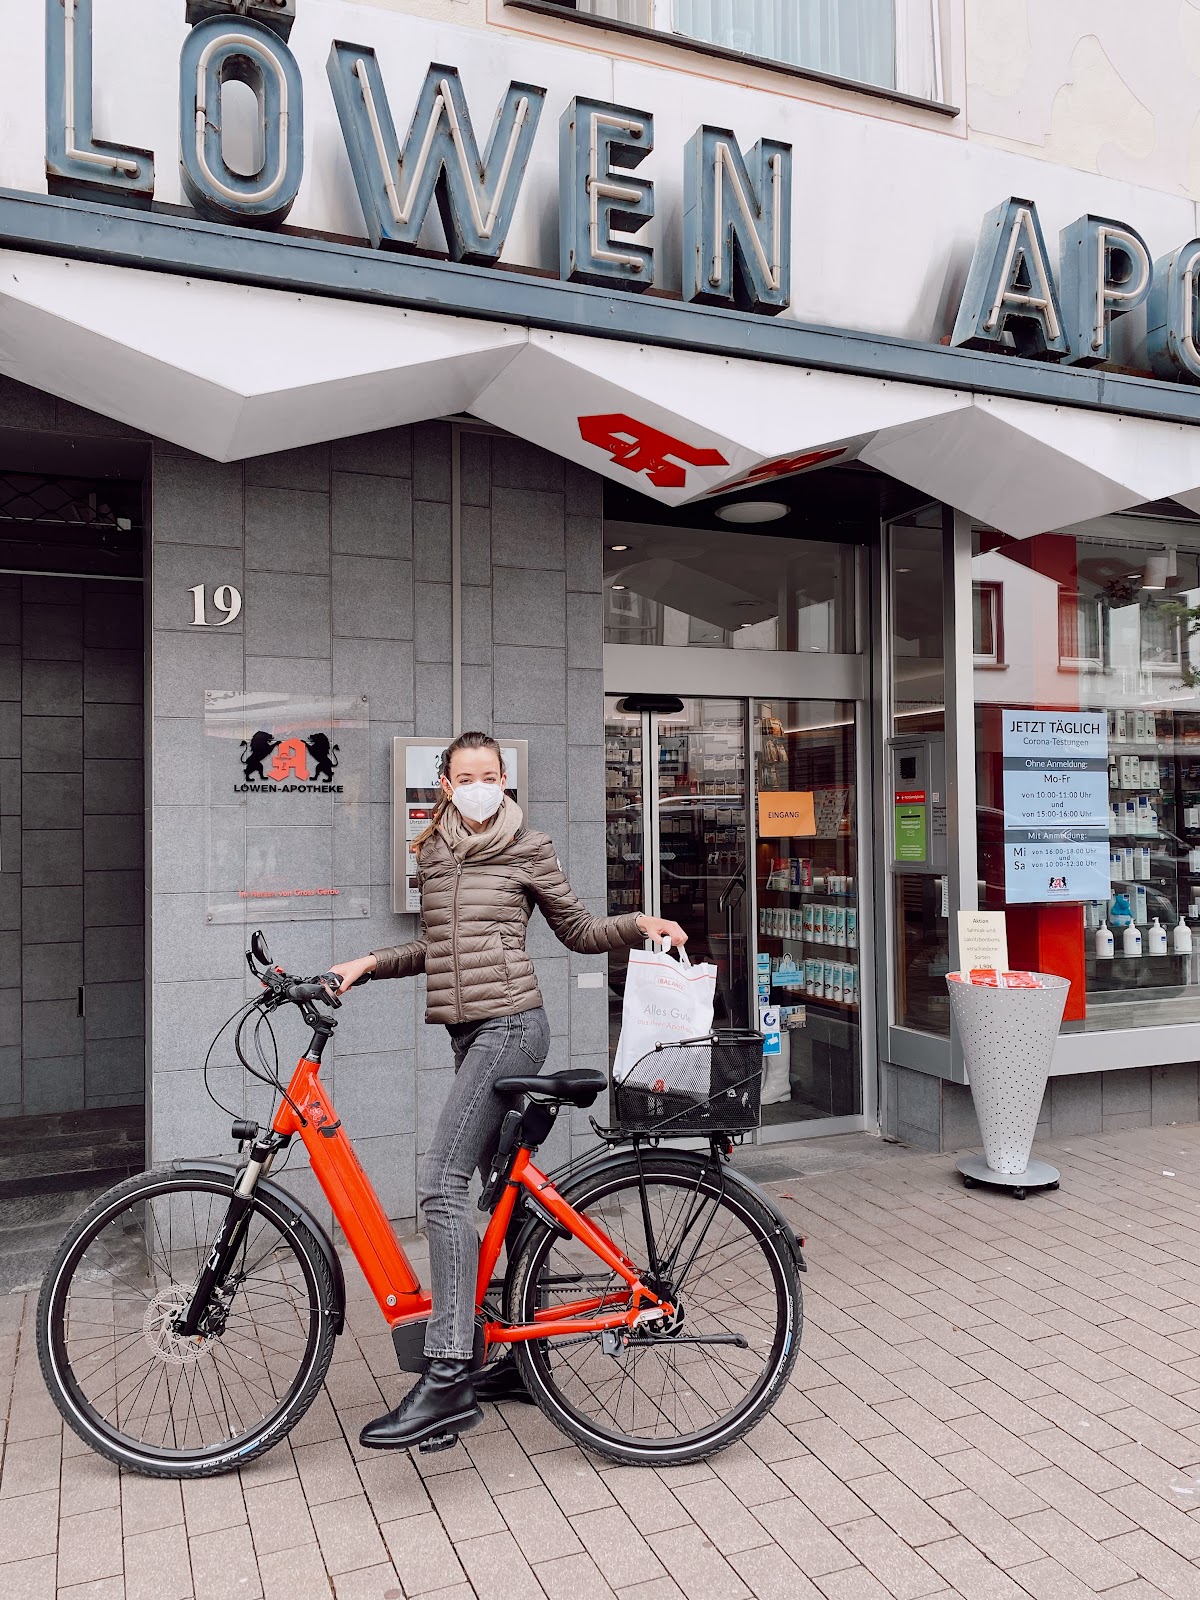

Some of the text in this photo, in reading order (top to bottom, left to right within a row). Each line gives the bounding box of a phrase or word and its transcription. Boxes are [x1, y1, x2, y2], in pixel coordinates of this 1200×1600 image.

[187, 584, 243, 626] 19
[1010, 719, 1100, 734] JETZT TÄGLICH
[1023, 736, 1089, 748] Corona-Testungen
[1025, 759, 1088, 769] Ohne Anmeldung:
[1044, 774, 1071, 783] Mo-Fr
[233, 783, 345, 794] LÖWEN-APOTHEKE
[1037, 791, 1078, 799] 10:00-11:00
[768, 811, 800, 819] EINGANG
[1037, 810, 1079, 818] 15:00-16:00
[1028, 832, 1041, 840] Mit
[1013, 847, 1026, 857] Mi
[1014, 861, 1026, 870] Sa
[643, 1004, 667, 1017] Alles
